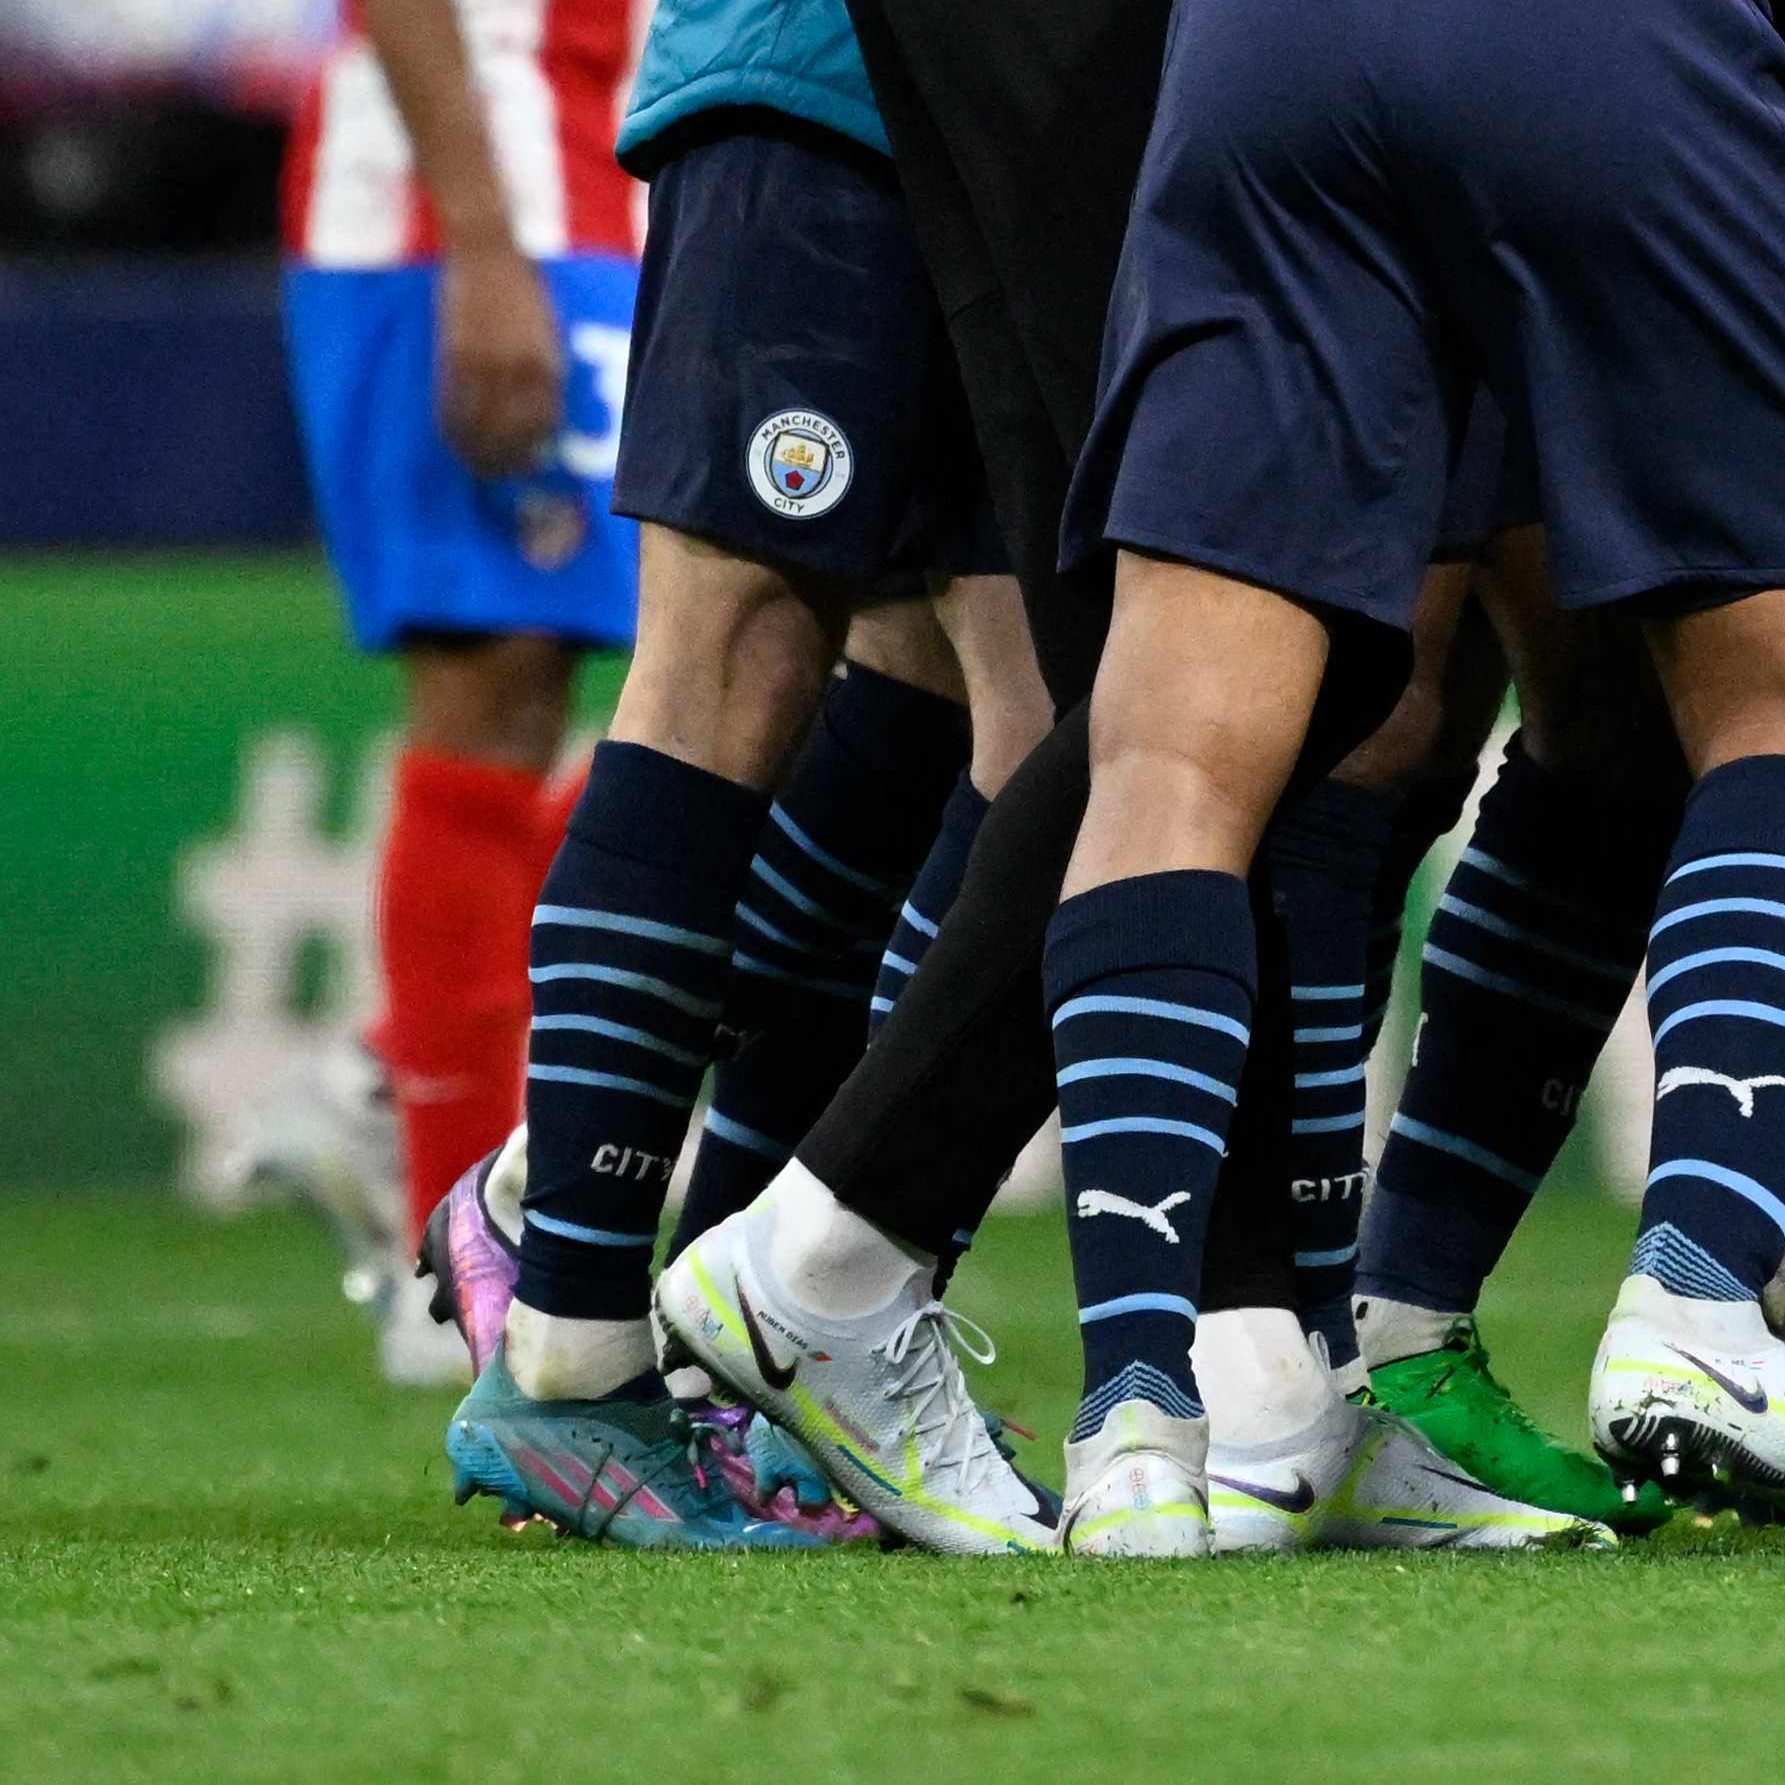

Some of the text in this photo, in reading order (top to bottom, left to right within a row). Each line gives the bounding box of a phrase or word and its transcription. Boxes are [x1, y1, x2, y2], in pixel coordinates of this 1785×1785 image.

[761, 415, 847, 461] MANCHESTER
[773, 497, 806, 514] CITY
[1291, 1167, 1369, 1202] CIT
